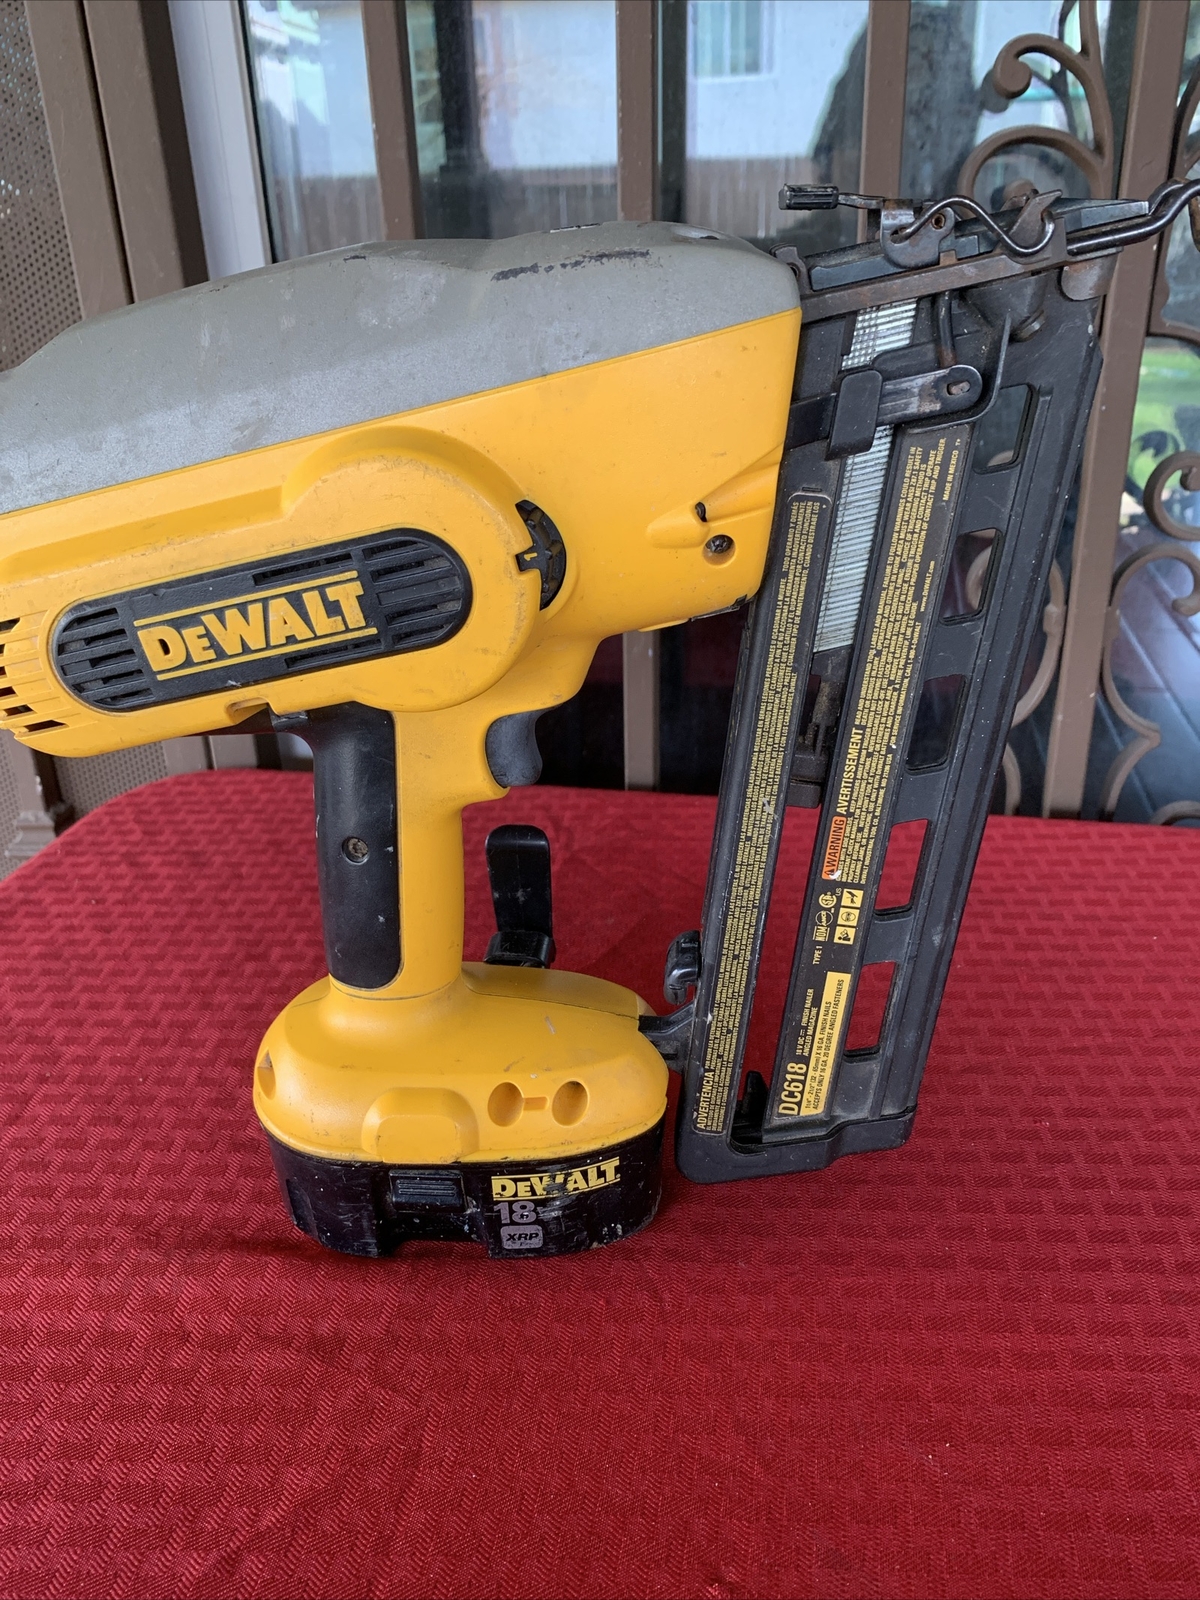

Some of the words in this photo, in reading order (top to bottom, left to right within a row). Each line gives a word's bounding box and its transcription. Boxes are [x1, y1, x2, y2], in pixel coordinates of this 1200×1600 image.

[909, 446, 915, 454] IN
[913, 447, 923, 470] SAFETY
[904, 454, 914, 477] RESULT
[942, 482, 952, 500] MADE
[948, 449, 958, 473] MEXICO
[900, 477, 909, 497] COULD
[906, 486, 915, 501] ANSI
[893, 498, 905, 531] WARNINGS
[902, 502, 911, 521] WEAR
[899, 521, 907, 539] MUST
[889, 532, 898, 555] FOLLOW
[895, 539, 904, 555] AREA
[524, 553, 538, 561] 1
[887, 556, 893, 564] TO
[891, 555, 900, 573] WORK
[882, 564, 892, 588] FAILURE
[885, 582, 895, 604] OTHERS
[874, 614, 882, 627] AND
[870, 627, 879, 648] LABELS
[875, 618, 888, 652] OPERATORS
[867, 648, 875, 662] TOOL
[860, 662, 872, 698] UNDERSTAND
[865, 677, 875, 699] SERIOUS
[854, 710, 862, 724] READ
[860, 708, 869, 725] DEATH
[836, 727, 863, 814] AVERTISSEMENT
[825, 818, 844, 868] WARNING
[835, 887, 842, 895] US
[814, 925, 827, 941] NOM
[812, 949, 821, 965] TYPE
[804, 988, 813, 1007] NAILER
[832, 978, 844, 1009] FASTENERS
[801, 1008, 809, 1026] FINISH
[822, 1000, 831, 1017] NAILS
[819, 1017, 828, 1035] FINISH
[828, 1009, 838, 1030] ANGLED
[797, 1035, 804, 1044] DC
[802, 1035, 812, 1056] ANGLED
[807, 1006, 817, 1034] MAGAZINE
[824, 1031, 833, 1051] DEGREE
[777, 1061, 807, 1115] DC618
[817, 1074, 825, 1087] ONLY
[696, 1070, 714, 1129] ADVERTENCIA
[812, 1087, 822, 1109] ACCEPTS
[493, 1200, 537, 1224] 18
[506, 1232, 540, 1242] XRP
